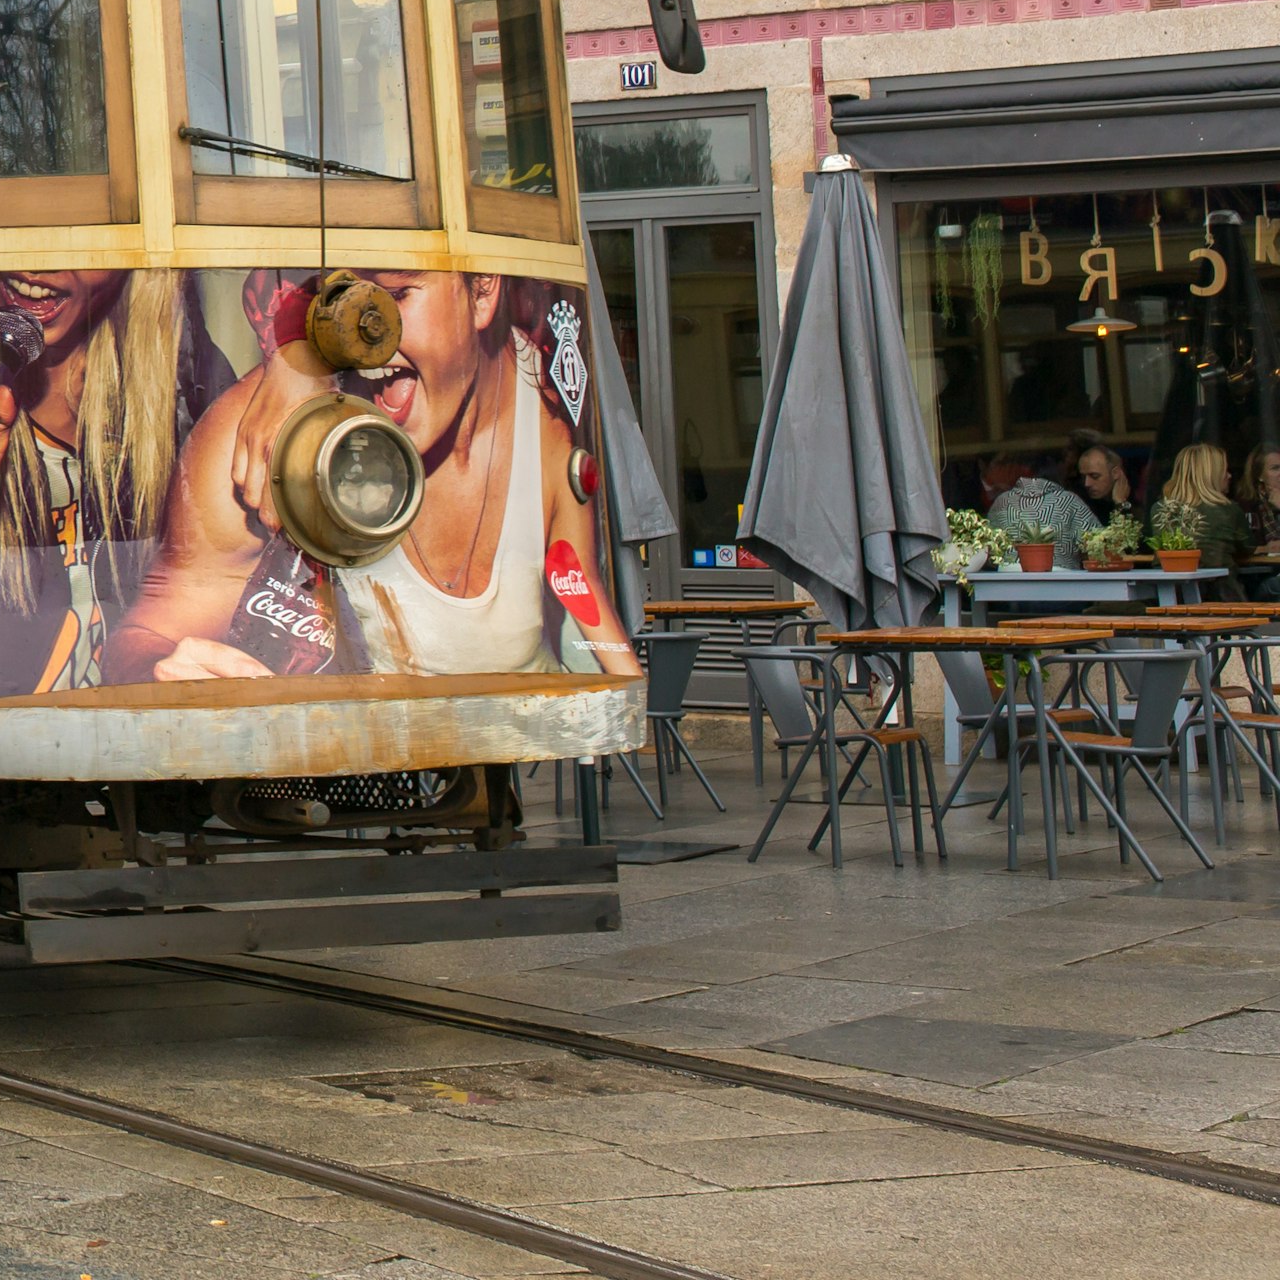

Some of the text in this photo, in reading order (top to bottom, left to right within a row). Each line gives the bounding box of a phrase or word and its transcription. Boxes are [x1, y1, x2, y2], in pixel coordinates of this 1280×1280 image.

[622, 64, 650, 87] 101
[266, 577, 295, 598] zero
[246, 591, 335, 650] Coca-Cola
